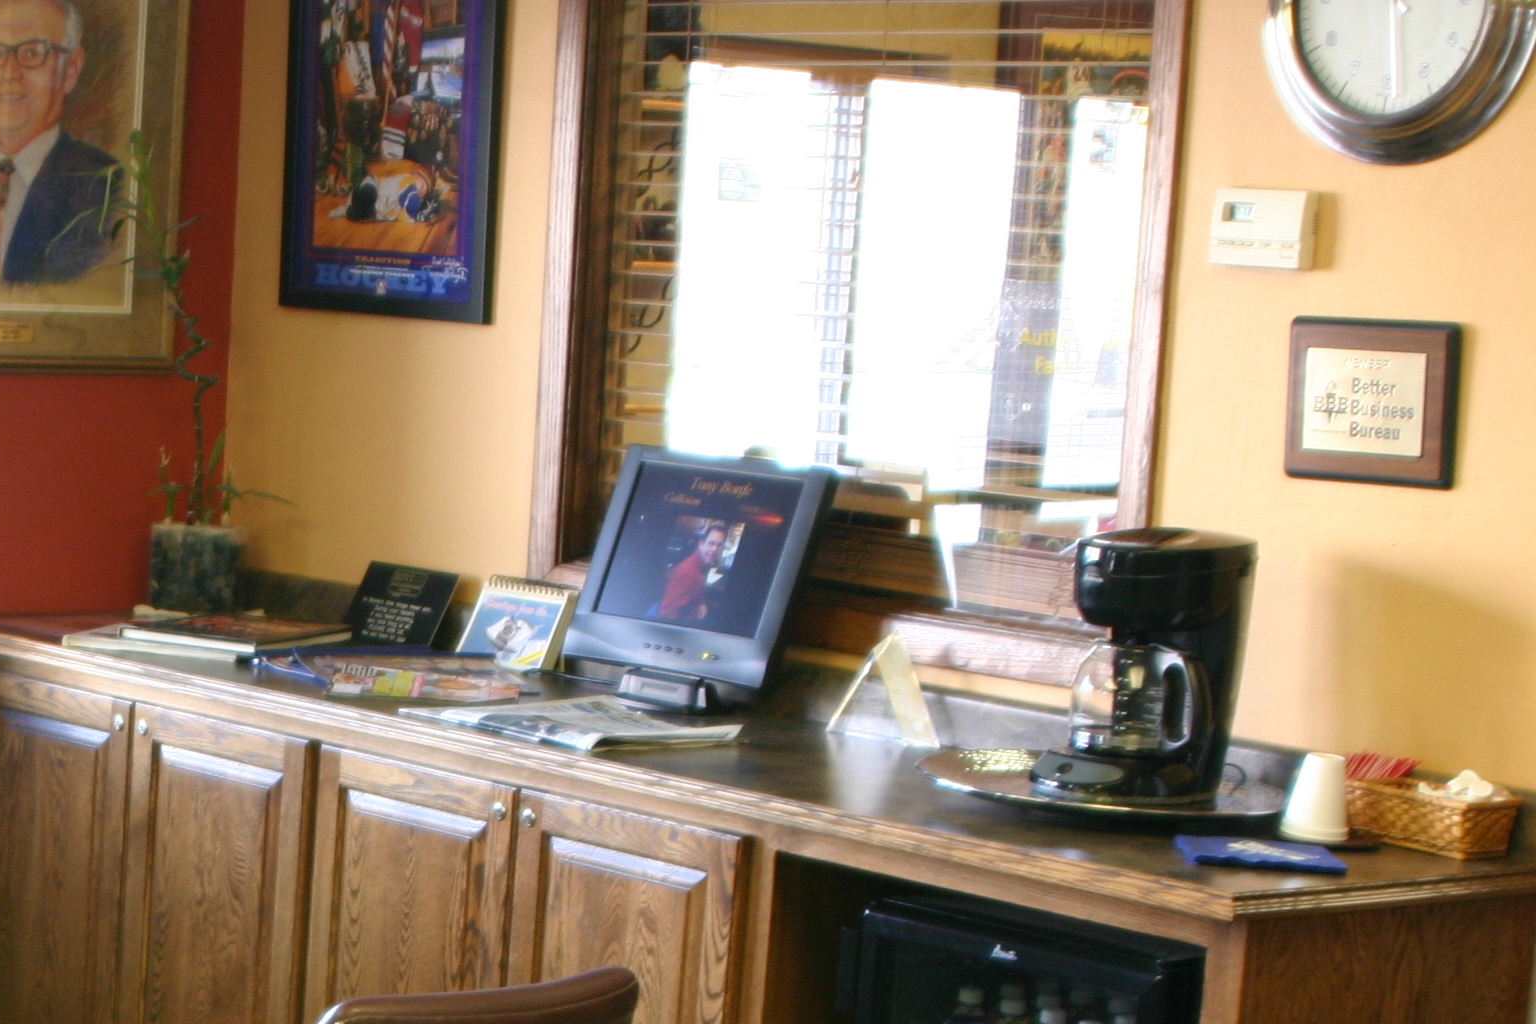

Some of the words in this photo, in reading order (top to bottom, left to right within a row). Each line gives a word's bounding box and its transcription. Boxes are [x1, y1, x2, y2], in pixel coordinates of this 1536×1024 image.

[1349, 60, 1361, 77] 7
[353, 255, 412, 265] TRADITION
[315, 262, 448, 294] HOCKEY
[1352, 377, 1397, 396] Better
[1350, 399, 1416, 420] Business
[1348, 420, 1402, 441] Bureau
[691, 476, 719, 496] Tony
